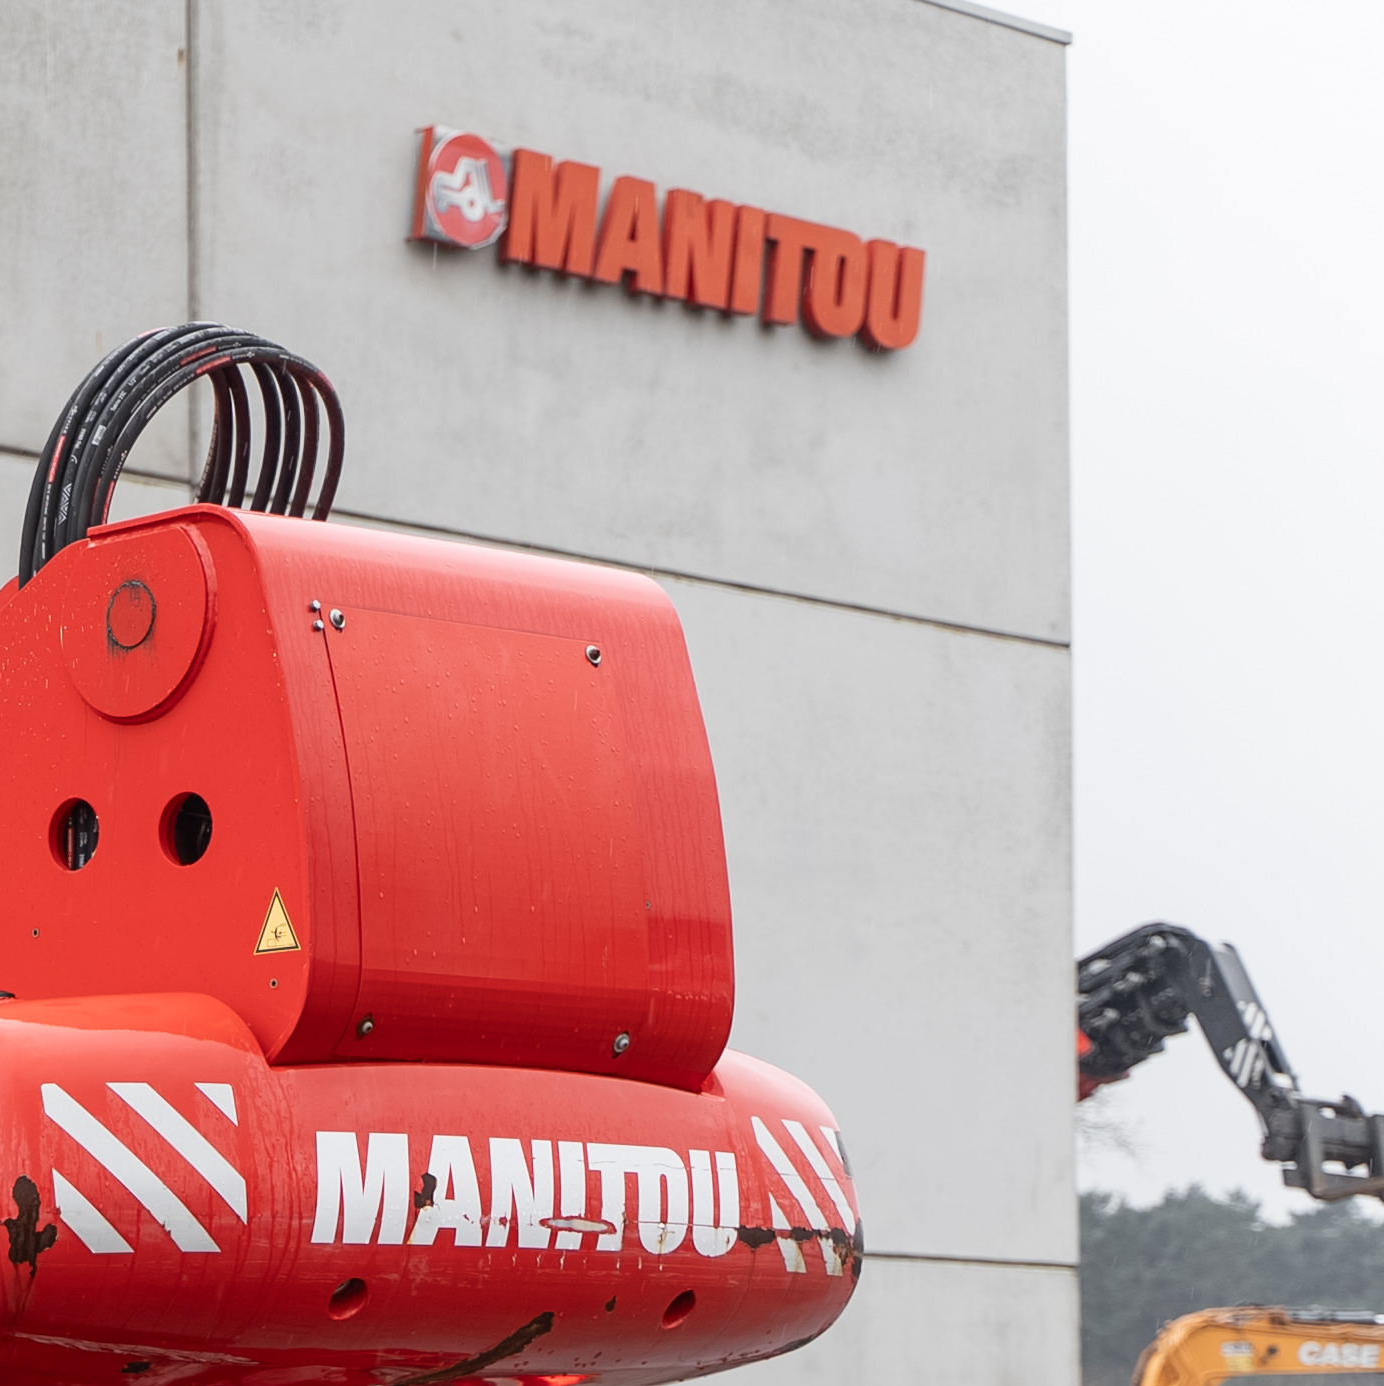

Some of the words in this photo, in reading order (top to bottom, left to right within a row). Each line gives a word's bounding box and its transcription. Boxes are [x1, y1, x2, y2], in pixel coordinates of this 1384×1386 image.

[501, 147, 926, 349] MANITOU
[310, 1130, 737, 1258] MANITOU
[1298, 1341, 1381, 1368] CASE
